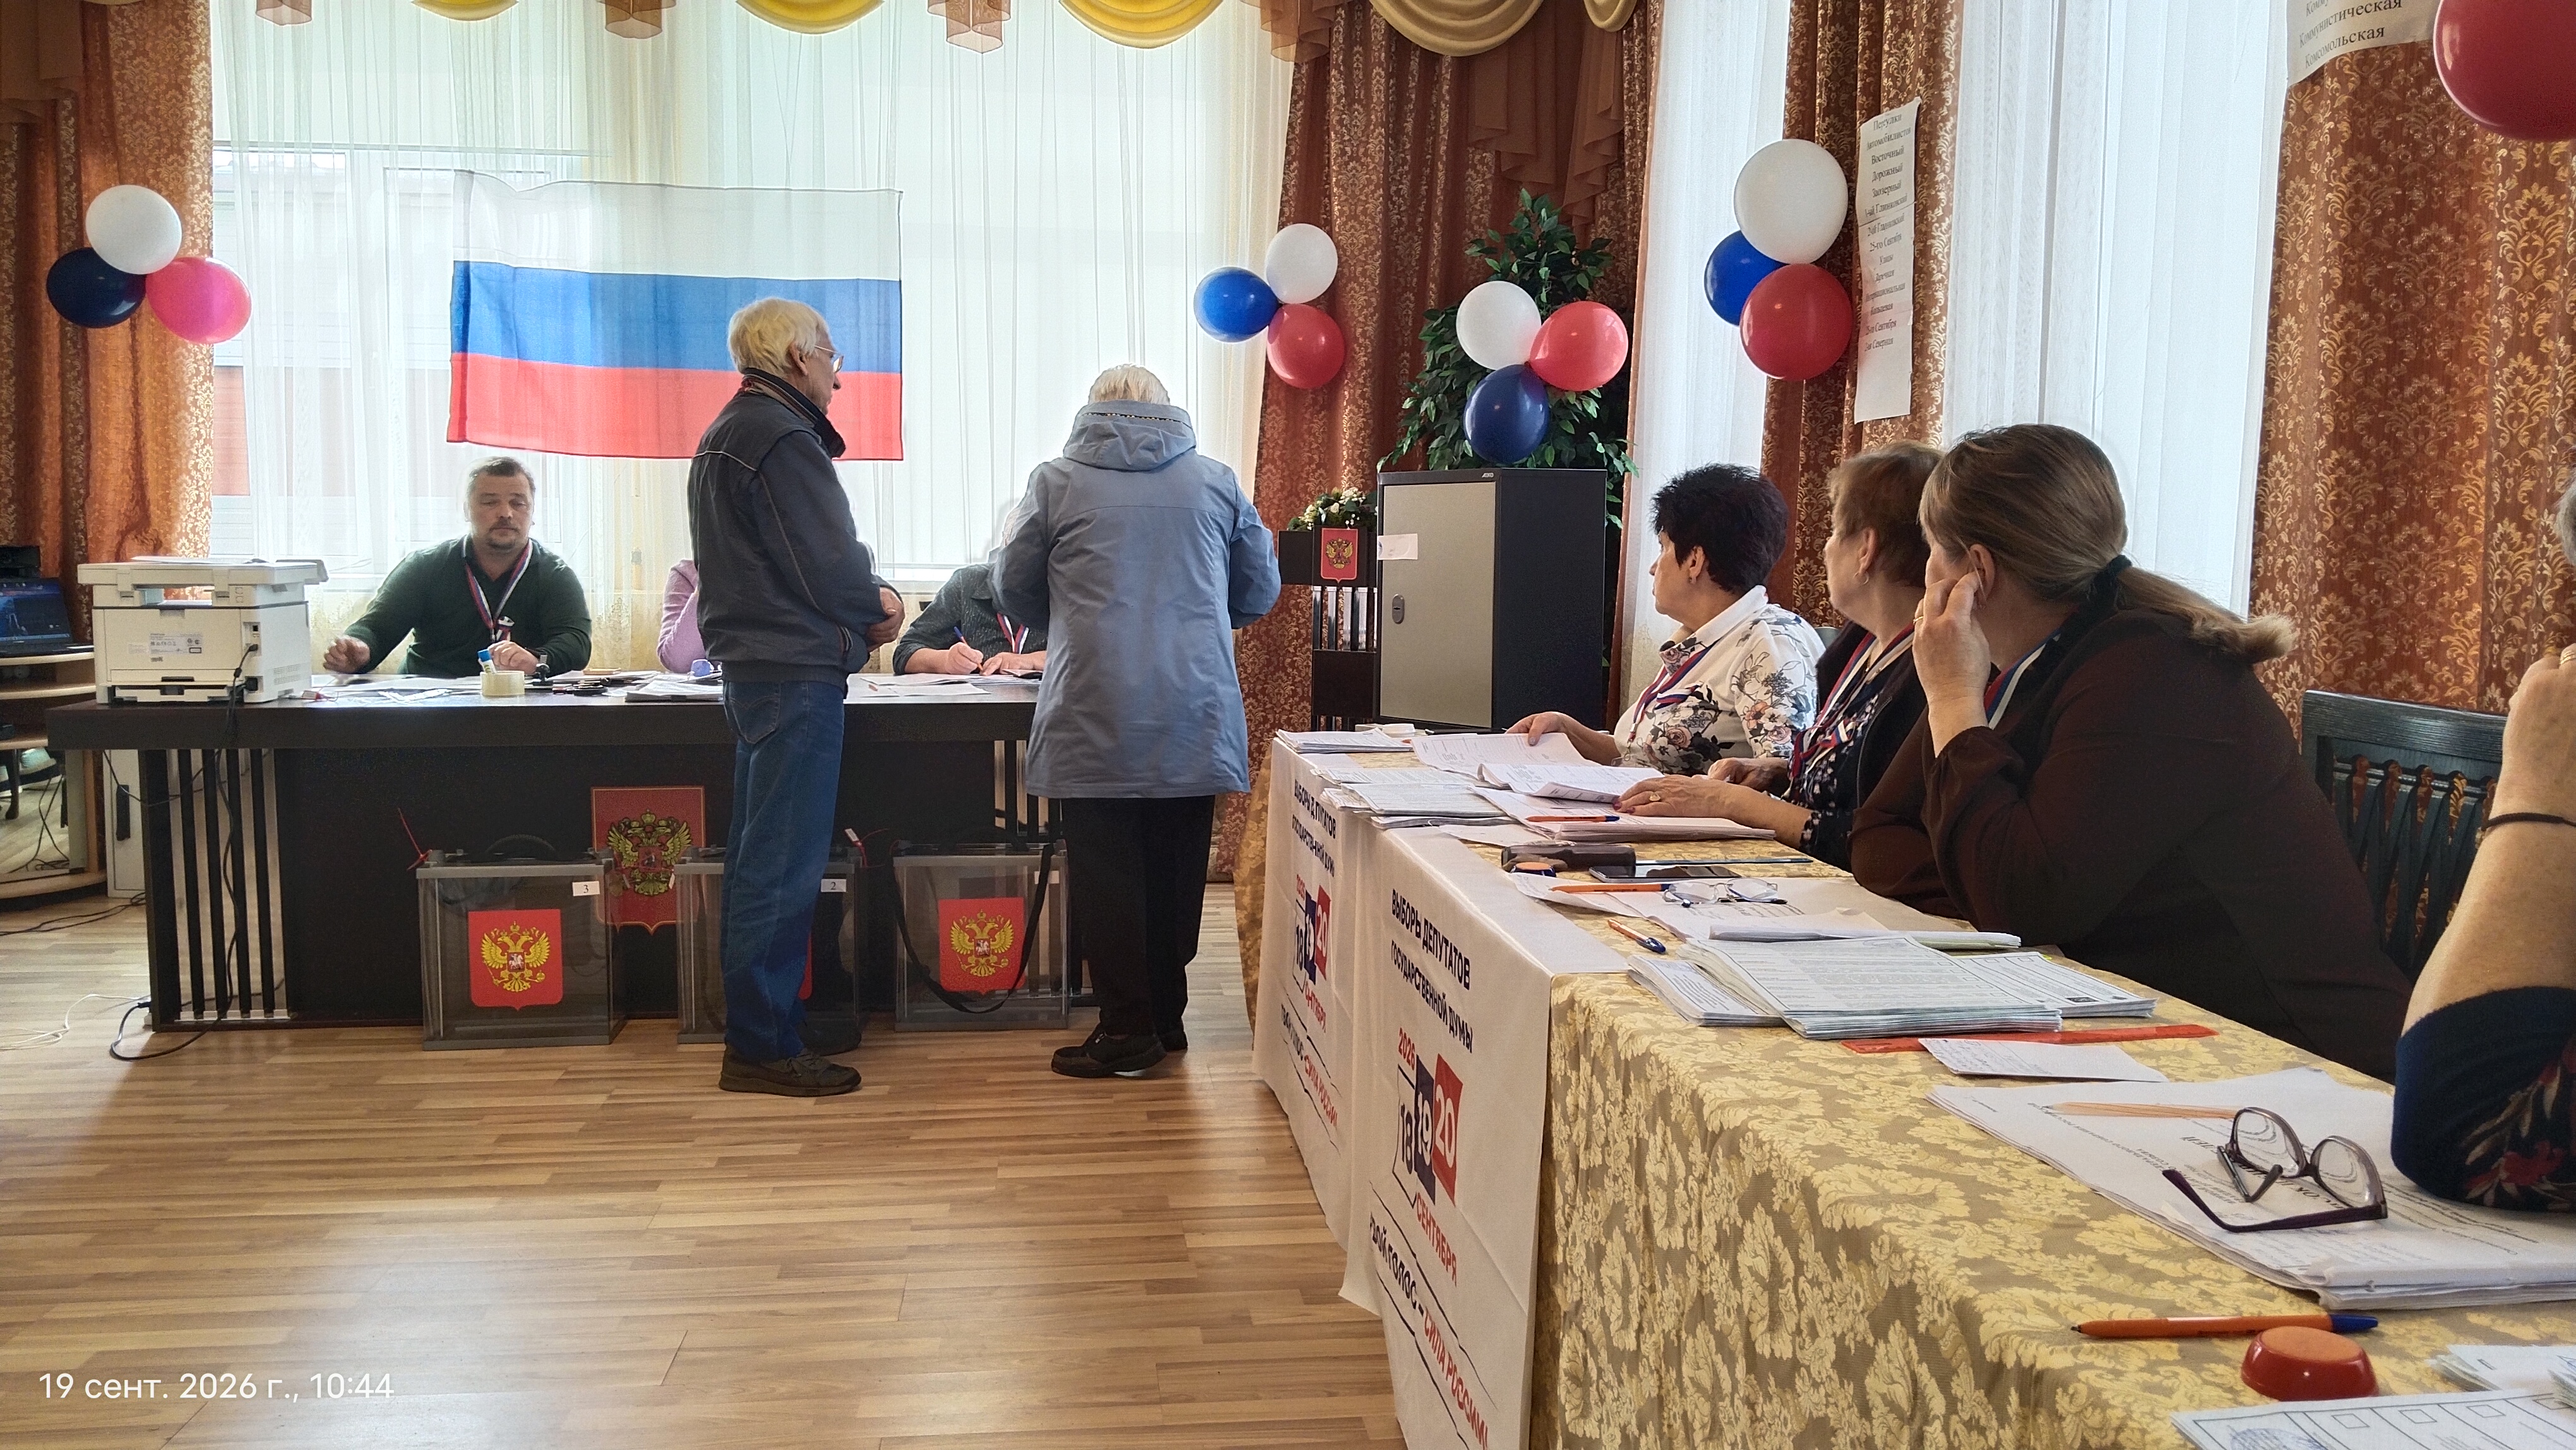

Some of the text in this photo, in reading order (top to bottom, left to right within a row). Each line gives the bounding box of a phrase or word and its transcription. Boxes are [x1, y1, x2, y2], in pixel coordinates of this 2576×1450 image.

[2299, 0, 2402, 48] Коммунистическая
[2305, 27, 2385, 69] Комсомольская
[1866, 127, 1911, 150] Автомобилистов
[1871, 145, 1904, 165] Восточный
[1871, 162, 1903, 183] Дорожный
[1311, 796, 1336, 839] ДПУТАТОВ
[583, 885, 588, 894] 3
[830, 882, 836, 890] 2
[1316, 904, 1328, 958] 20
[1422, 918, 1470, 990] ДЕПУТАТОВ
[1391, 940, 1473, 1054] ГОСУДАРСТВЕННОЙ ДУМЫ
[1398, 1027, 1415, 1070] 2026
[1400, 1084, 1455, 1175] 18 19 20
[1416, 1192, 1457, 1287] СЕНТЯБРЯ
[1388, 1243, 1417, 1309] ГОЛОС
[1424, 1306, 1446, 1374] СИЛА
